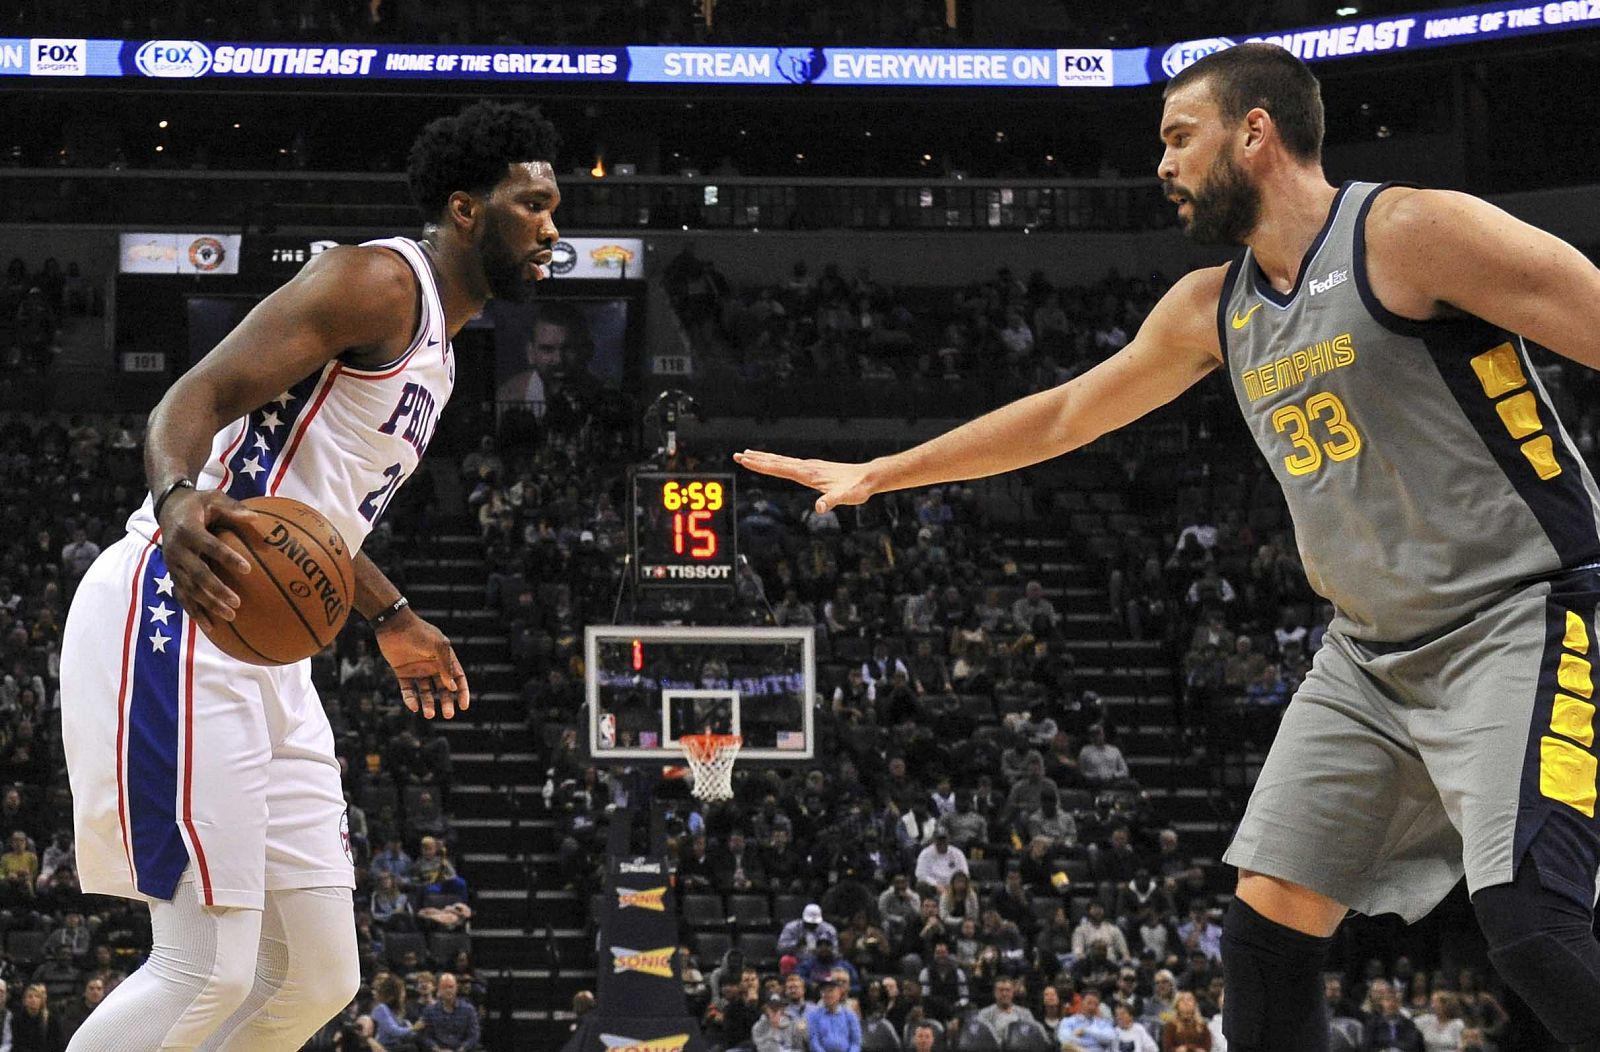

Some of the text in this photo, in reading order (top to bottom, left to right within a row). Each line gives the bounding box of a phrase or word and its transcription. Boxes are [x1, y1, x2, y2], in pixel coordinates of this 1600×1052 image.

[1424, 15, 1480, 40] HOME
[1479, 11, 1506, 33] OF
[1506, 7, 1543, 29] THE
[1244, 19, 1416, 60] UTHEAST
[0, 45, 23, 69] N
[38, 45, 78, 63] FOX
[153, 47, 193, 63] FOX
[212, 46, 378, 75] SOUTHEAST
[385, 53, 617, 74] HOME OF THE GRIZZLIES
[663, 52, 1050, 80] STREAM EVERYWHERE ON
[1064, 56, 1105, 72] FOX
[1308, 270, 1349, 296] FedEx
[1242, 333, 1356, 402] MEMPHIS
[1272, 391, 1362, 477] 33
[663, 481, 723, 511] 6:59
[672, 510, 718, 560] 15
[264, 522, 344, 627] SPALDING
[618, 954, 669, 969] SONIC
